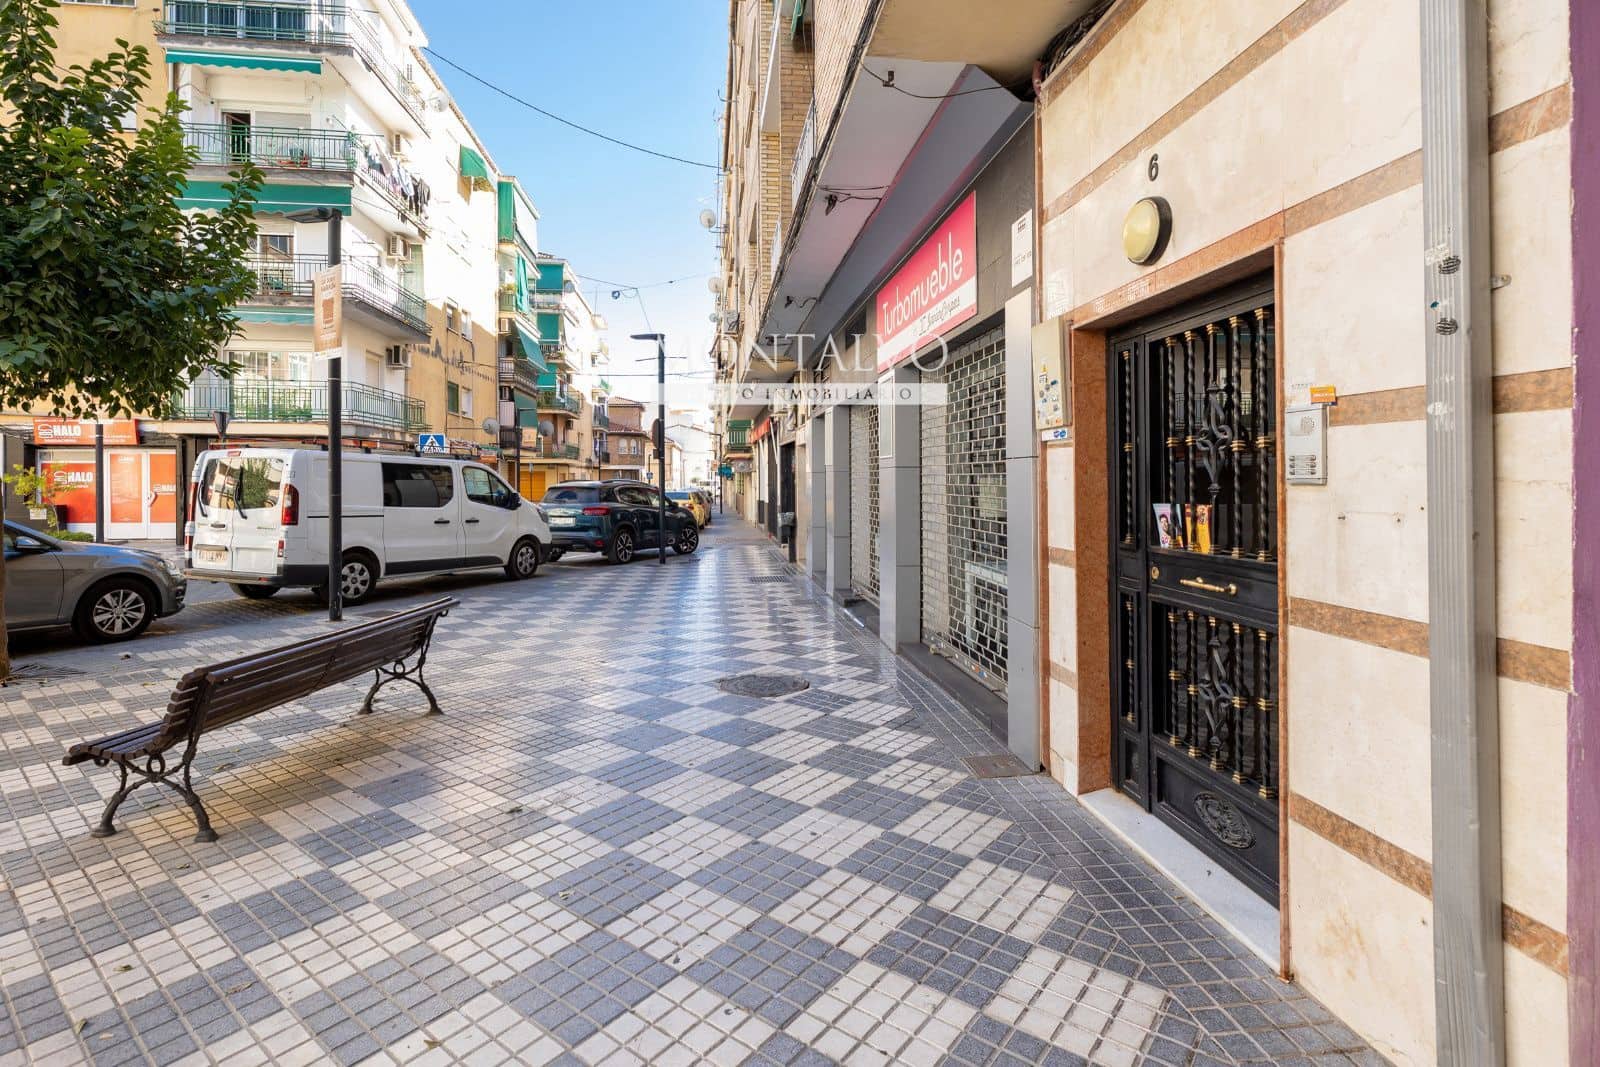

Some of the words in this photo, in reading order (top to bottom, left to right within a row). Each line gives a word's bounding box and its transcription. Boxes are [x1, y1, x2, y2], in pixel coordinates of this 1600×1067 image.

[1148, 153, 1159, 182] 6
[883, 231, 963, 336] Turbomueble
[53, 424, 82, 437] HALO
[67, 471, 94, 483] HALO
